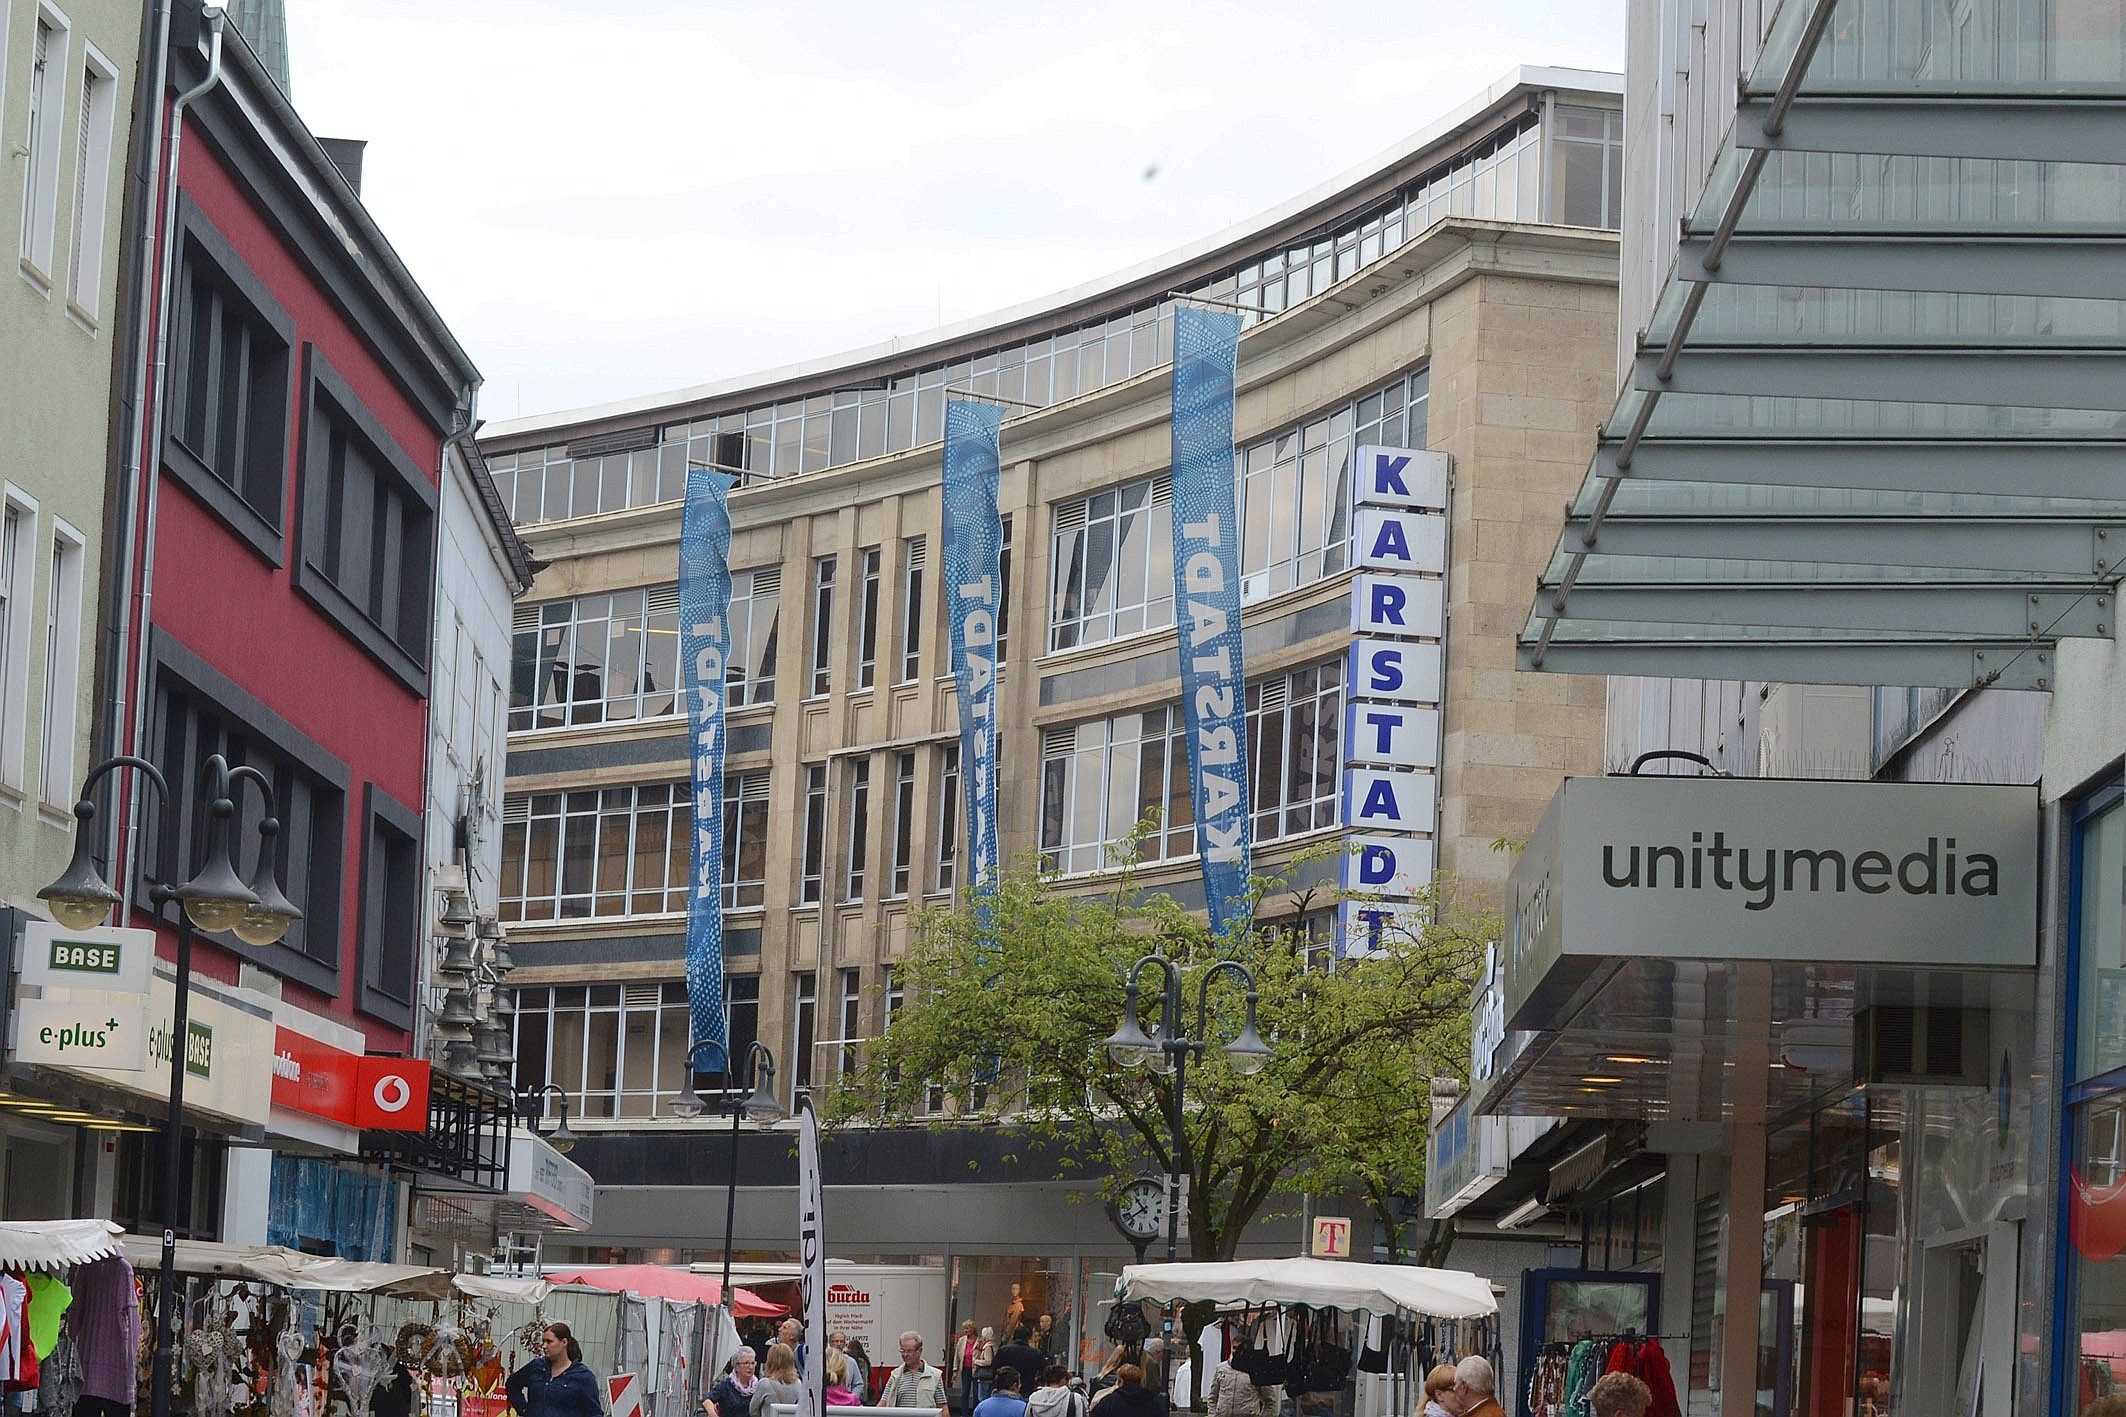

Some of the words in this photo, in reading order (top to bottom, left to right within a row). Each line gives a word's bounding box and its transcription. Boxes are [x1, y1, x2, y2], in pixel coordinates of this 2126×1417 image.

[1358, 454, 1411, 951] KARSTADT
[1602, 831, 1998, 911] unitymedia
[55, 946, 115, 968] BASE
[188, 1032, 210, 1064] BASE
[1319, 1222, 1345, 1253] T
[827, 1290, 870, 1303] burda
